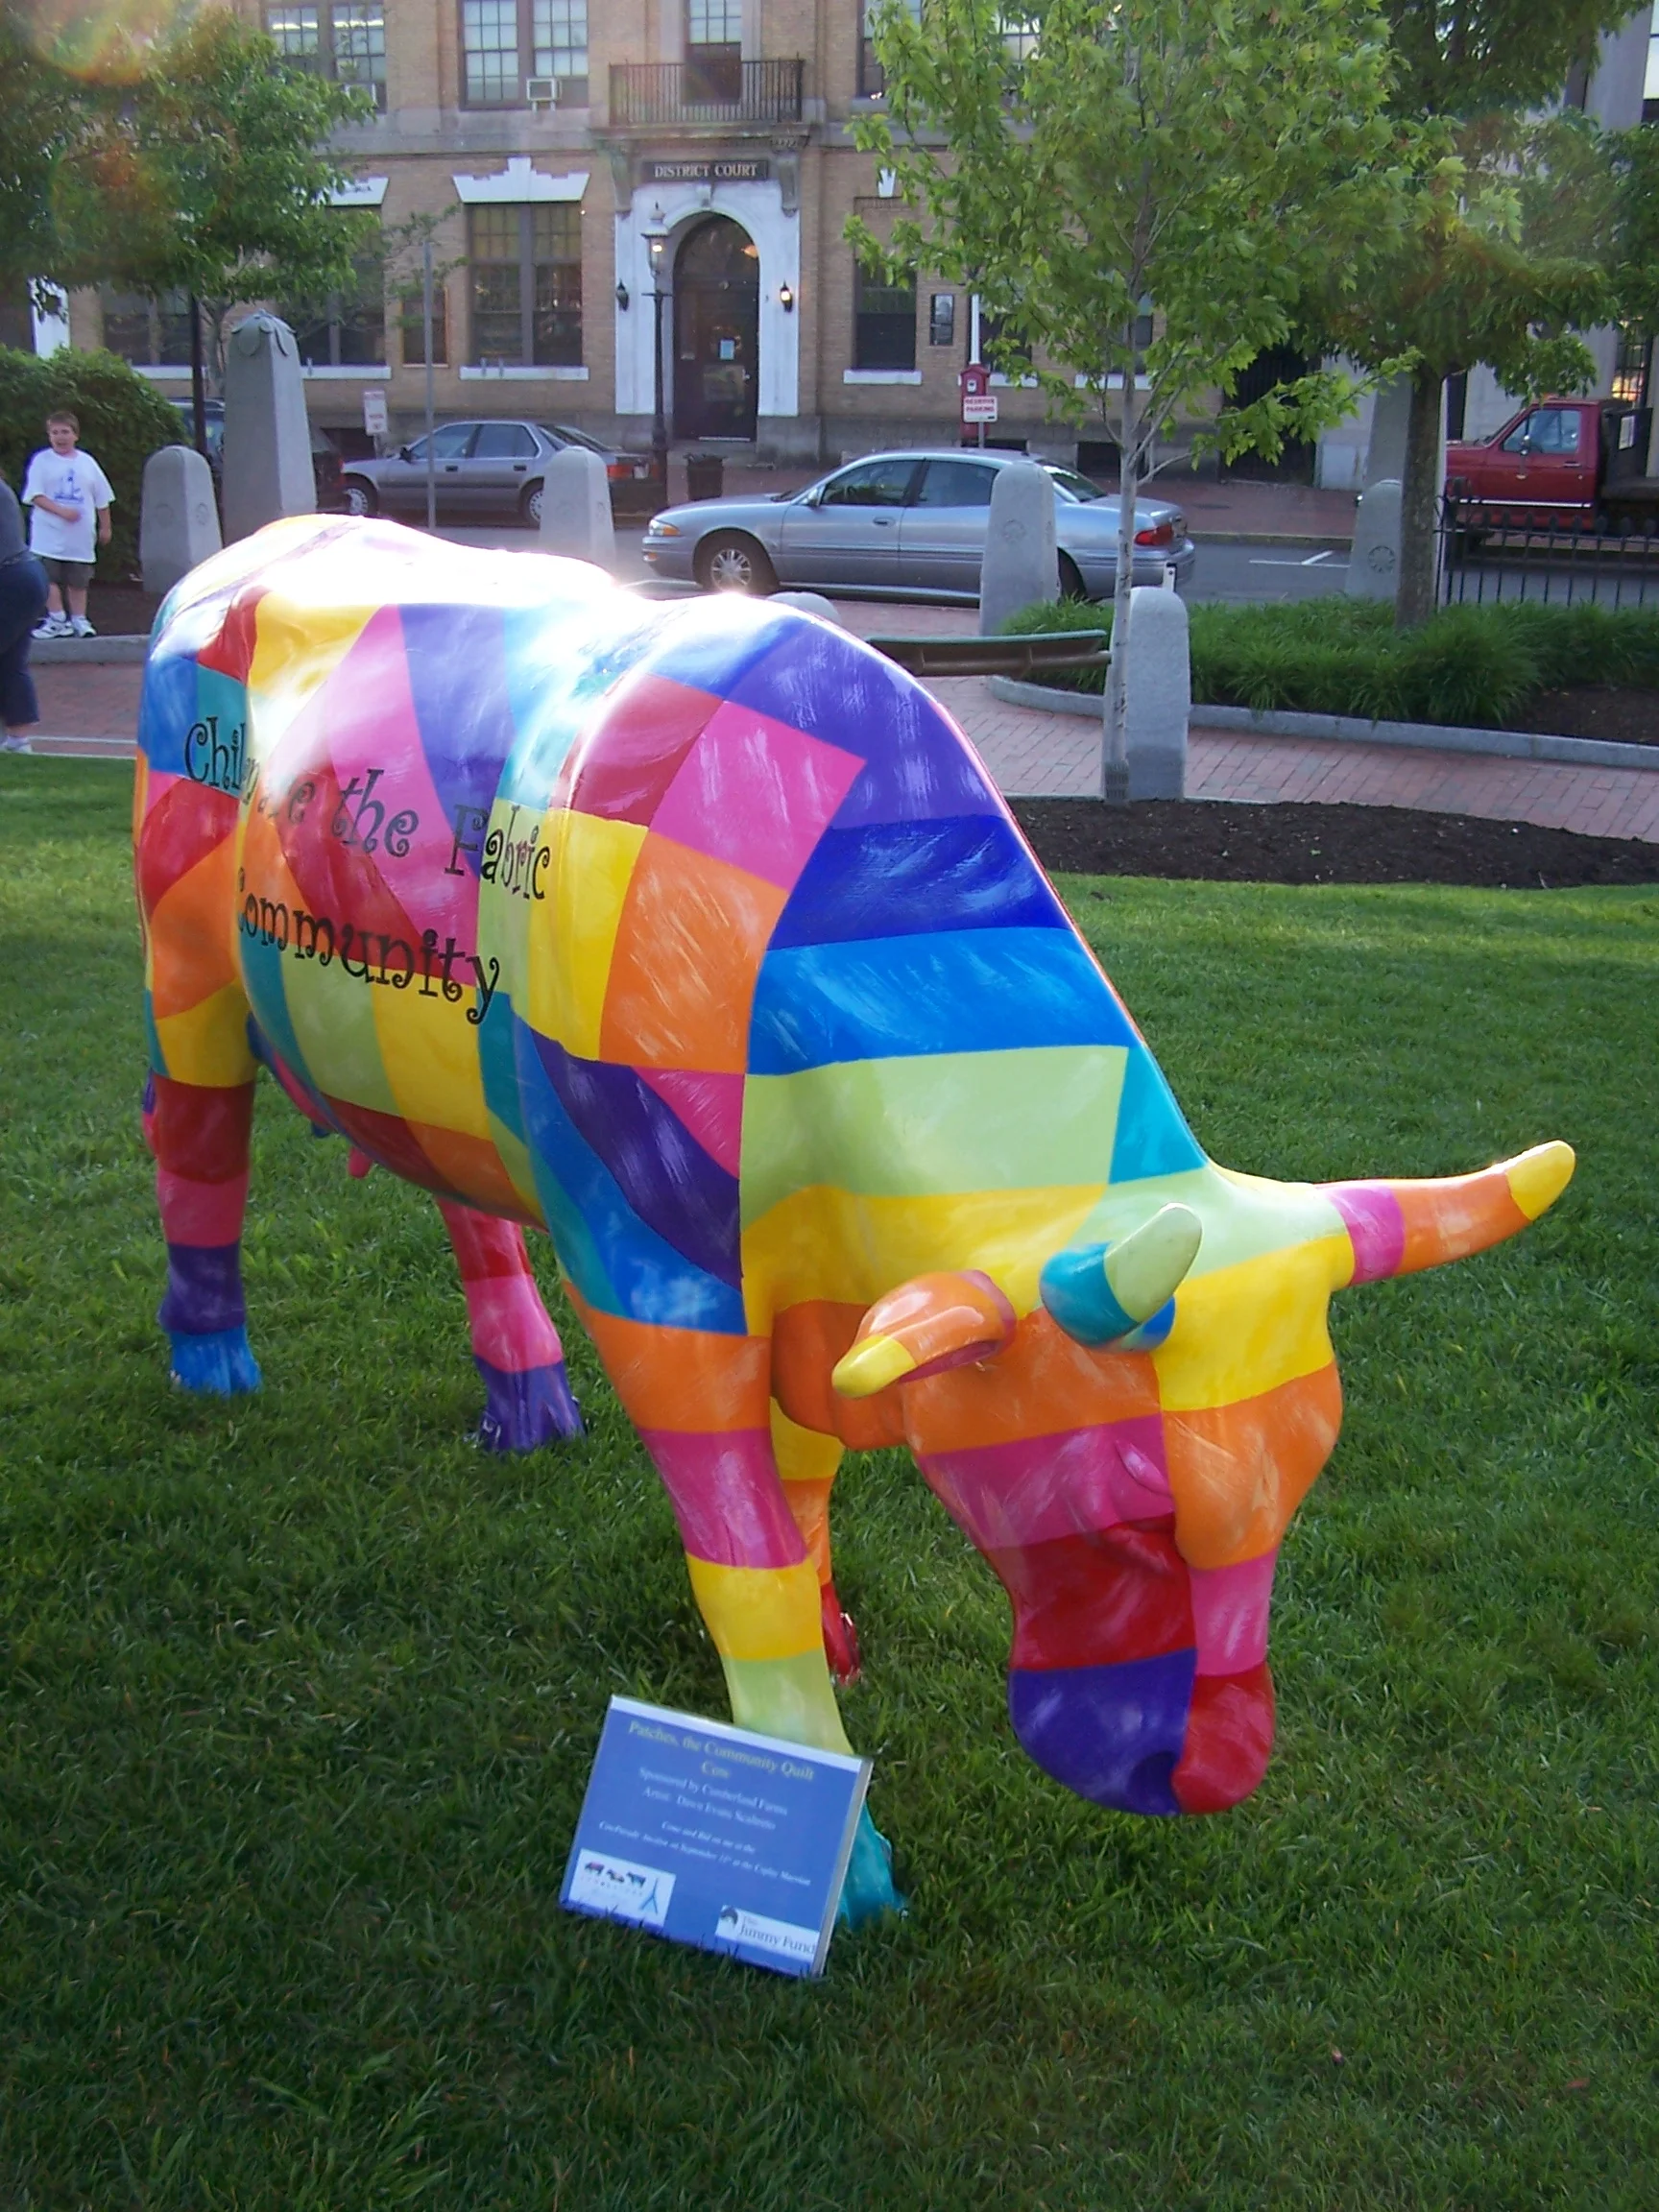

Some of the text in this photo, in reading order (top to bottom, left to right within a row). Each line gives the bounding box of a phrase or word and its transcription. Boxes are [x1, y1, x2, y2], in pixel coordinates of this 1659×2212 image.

[655, 163, 757, 178] DISTRICT COURT
[330, 769, 419, 857] the
[444, 804, 550, 900] Fabric
[704, 1741, 779, 1772] Community
[781, 1760, 815, 1781] Quilt
[741, 1925, 815, 1953] Jimmy Fund
